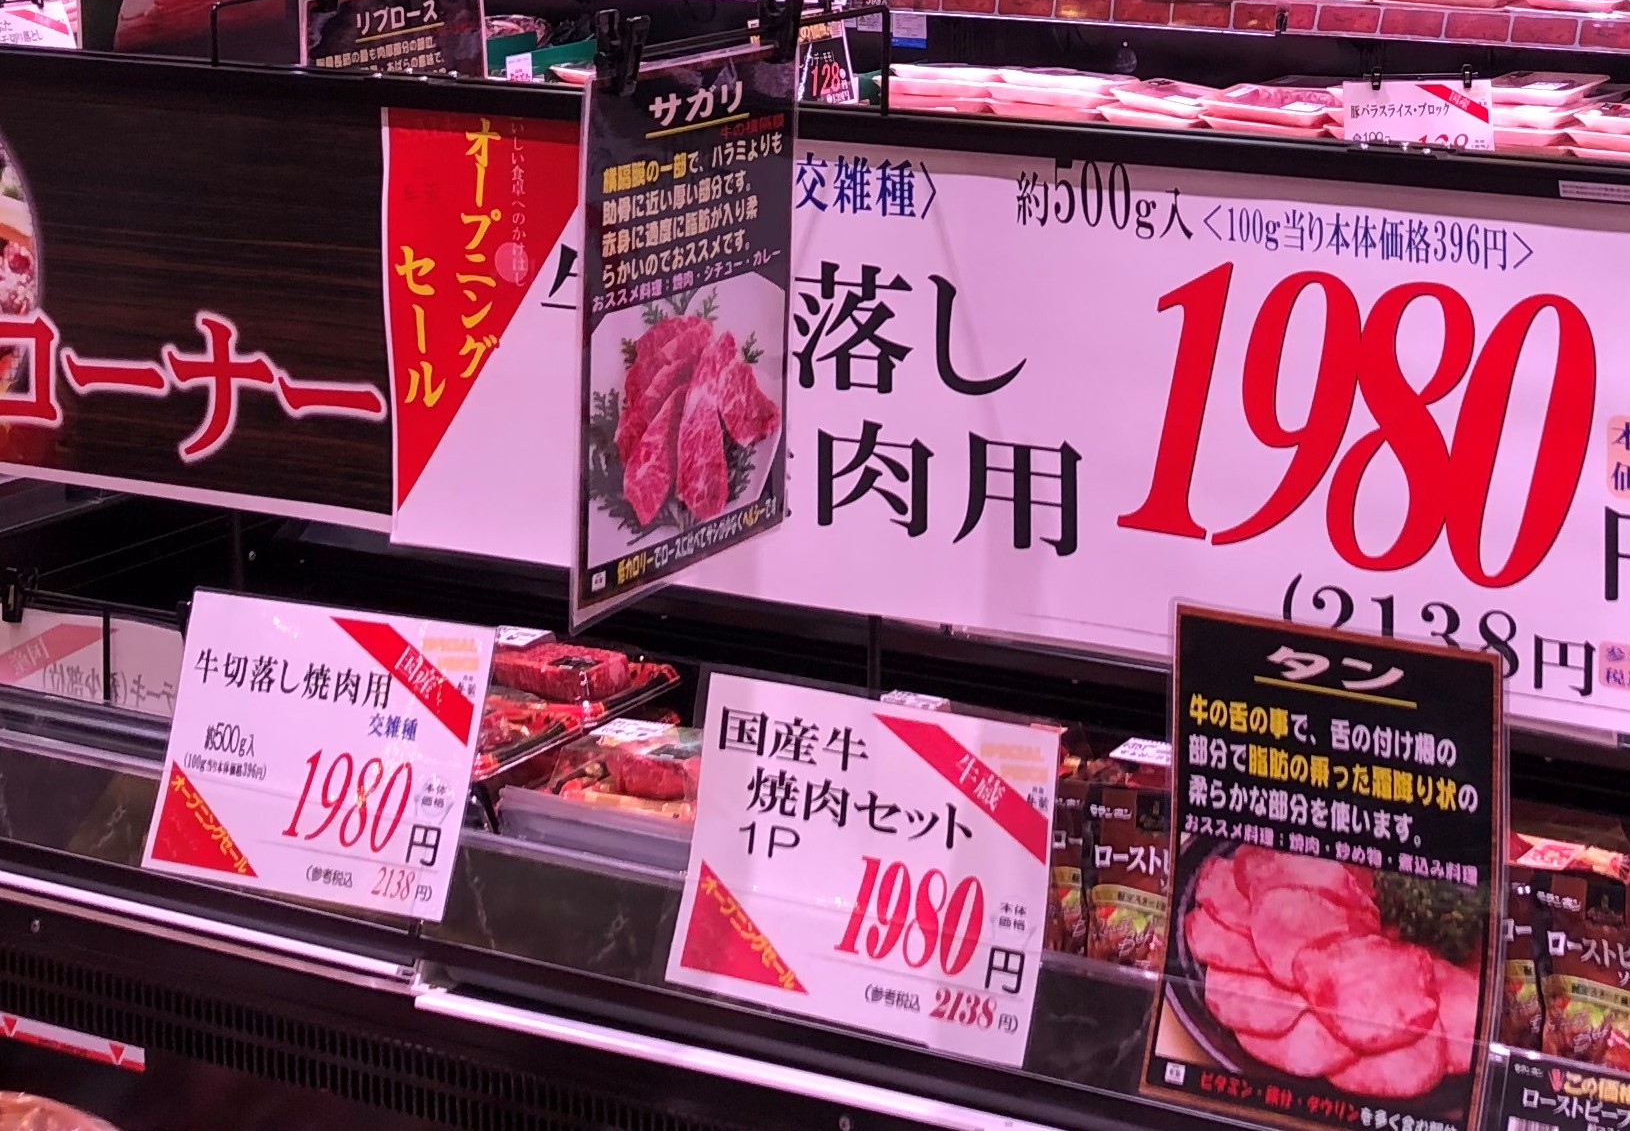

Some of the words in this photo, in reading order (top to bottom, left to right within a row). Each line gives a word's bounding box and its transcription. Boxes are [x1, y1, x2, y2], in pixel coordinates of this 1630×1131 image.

[356, 0, 438, 35] リブロース
[649, 81, 743, 127] サガリ
[1016, 159, 1193, 242] 約500g入
[456, 118, 501, 379] オープニング
[395, 245, 446, 408] セール
[793, 260, 1029, 398] 落し
[0, 312, 386, 462] コーナー
[1116, 260, 1597, 589] 1980
[817, 421, 1080, 556] 肉用
[194, 648, 393, 711] 牛切落し焼肉用
[395, 646, 437, 699] 国産
[1267, 646, 1405, 691] タン
[367, 713, 417, 742] 交雑種
[719, 705, 869, 772] 国産牛
[170, 773, 251, 875] オープニングセール
[281, 748, 414, 853] 1980
[738, 820, 801, 859] 1P
[746, 767, 974, 849] 焼肉セット
[701, 876, 796, 991] オープニングセール
[834, 855, 985, 975] 1980
